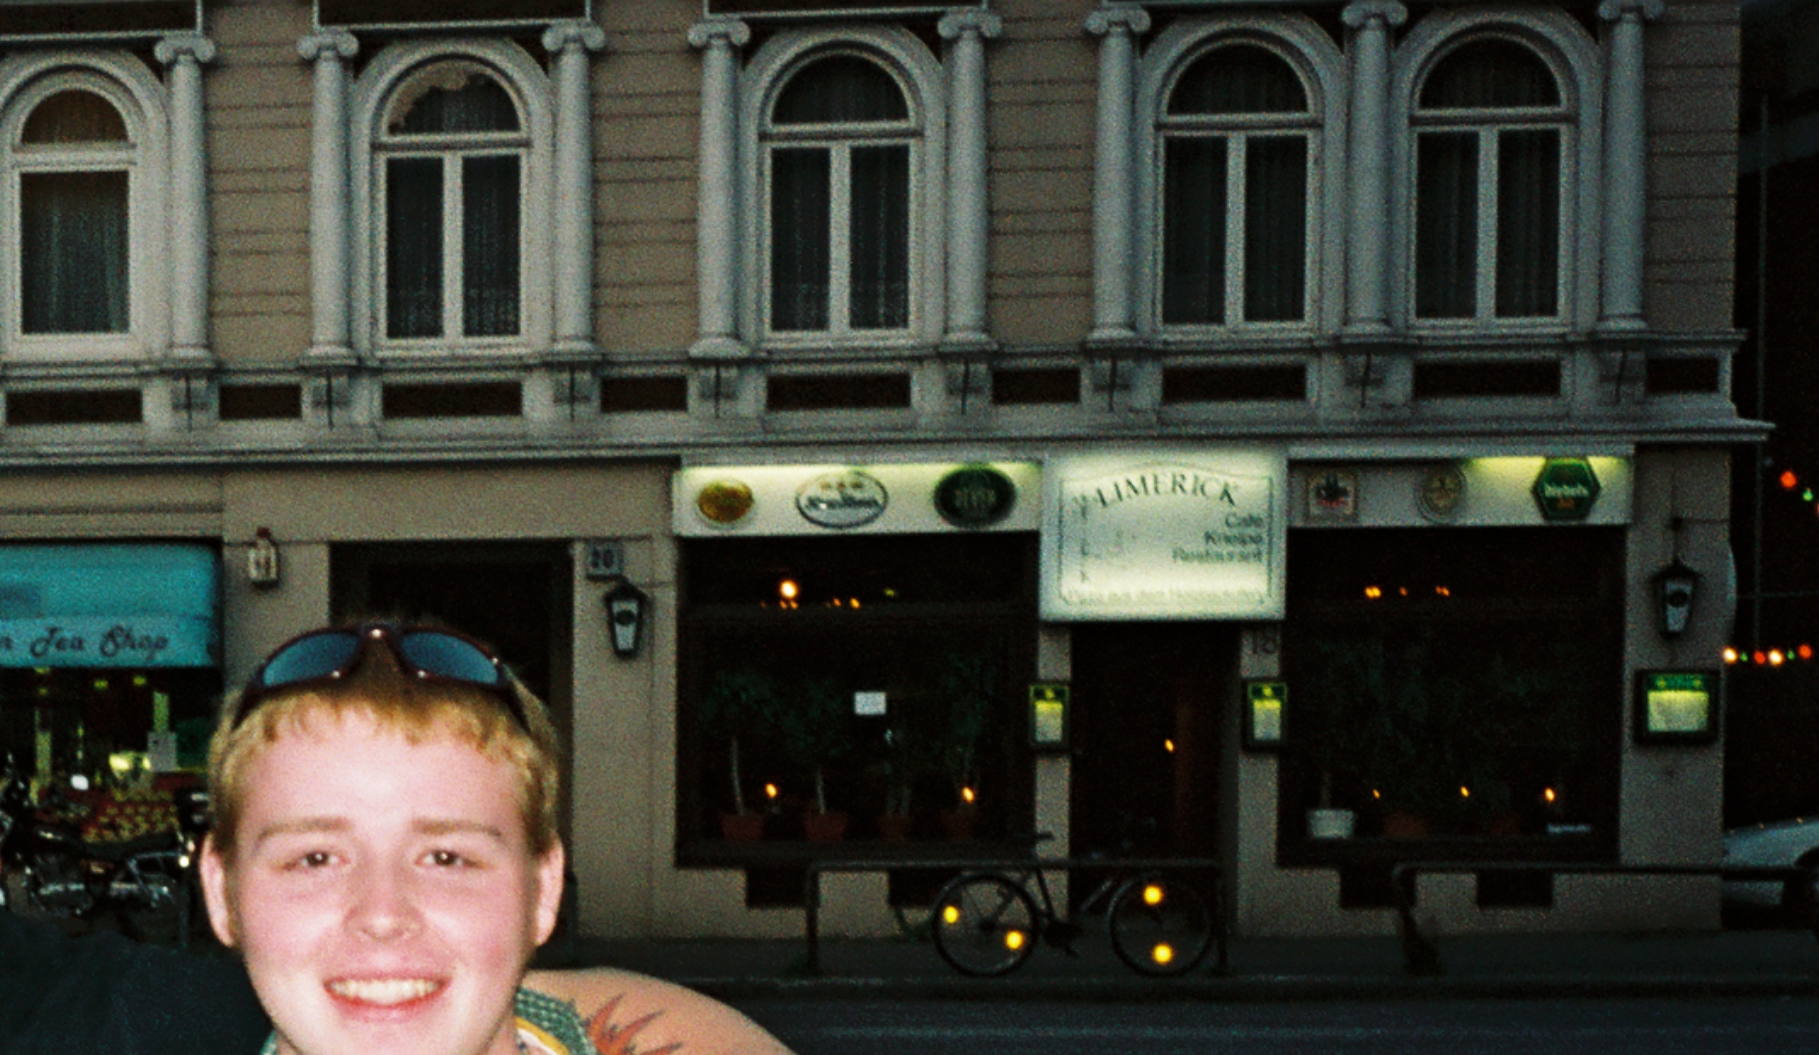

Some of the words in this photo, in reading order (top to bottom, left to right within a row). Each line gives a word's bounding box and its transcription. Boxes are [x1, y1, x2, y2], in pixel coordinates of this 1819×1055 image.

[1096, 472, 1238, 507] LIMERICK
[1204, 531, 1264, 547] Kneipe
[1172, 547, 1263, 563] Restaurant
[30, 627, 83, 658] Tea
[100, 625, 169, 661] Shop
